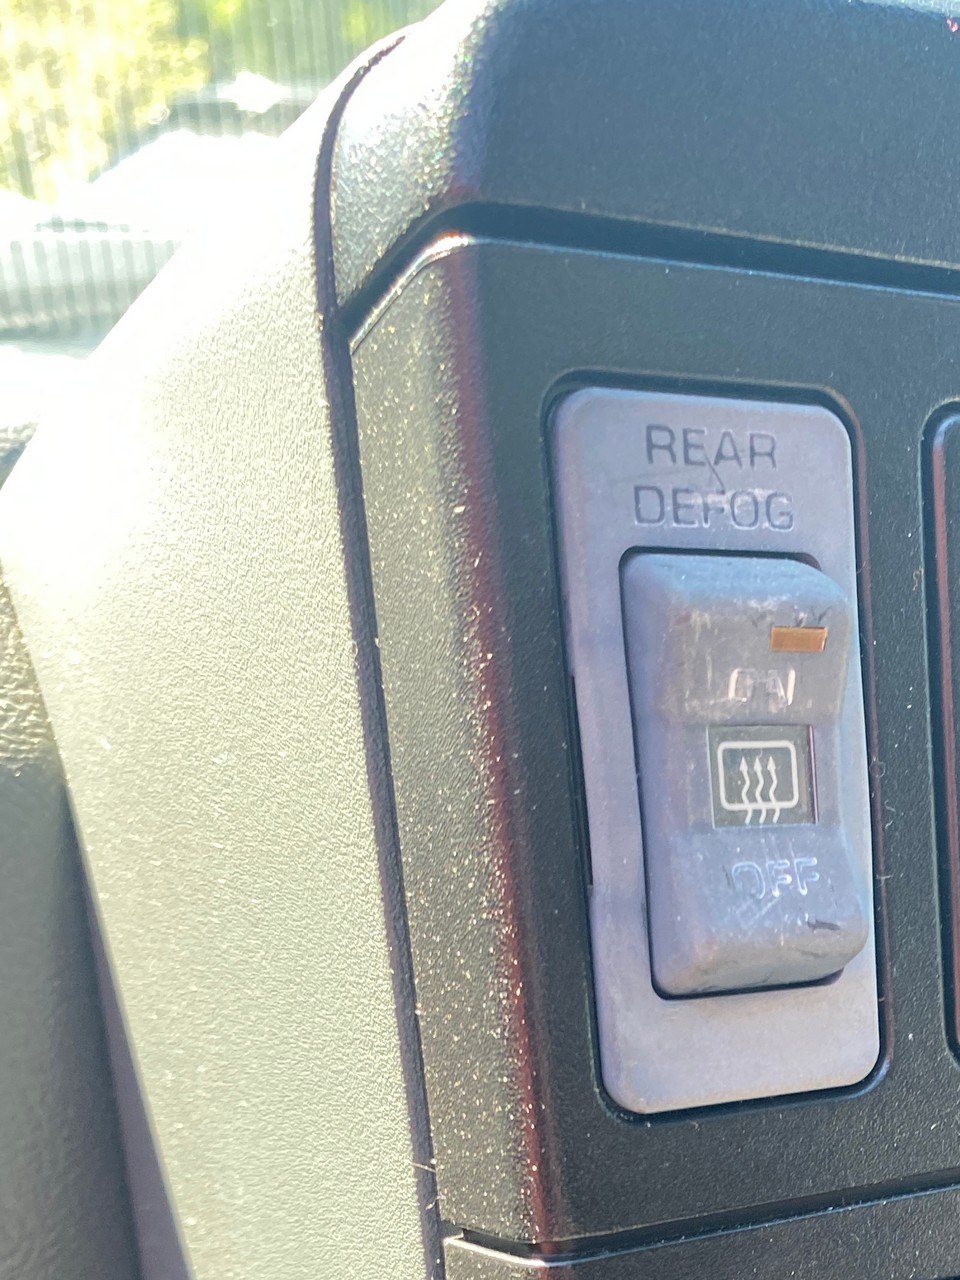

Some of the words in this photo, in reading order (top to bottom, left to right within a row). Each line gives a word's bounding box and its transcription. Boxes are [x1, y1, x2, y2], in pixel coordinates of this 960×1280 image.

[645, 423, 777, 470] REAR
[633, 485, 795, 532] DEFOG
[730, 857, 821, 900] OFF
